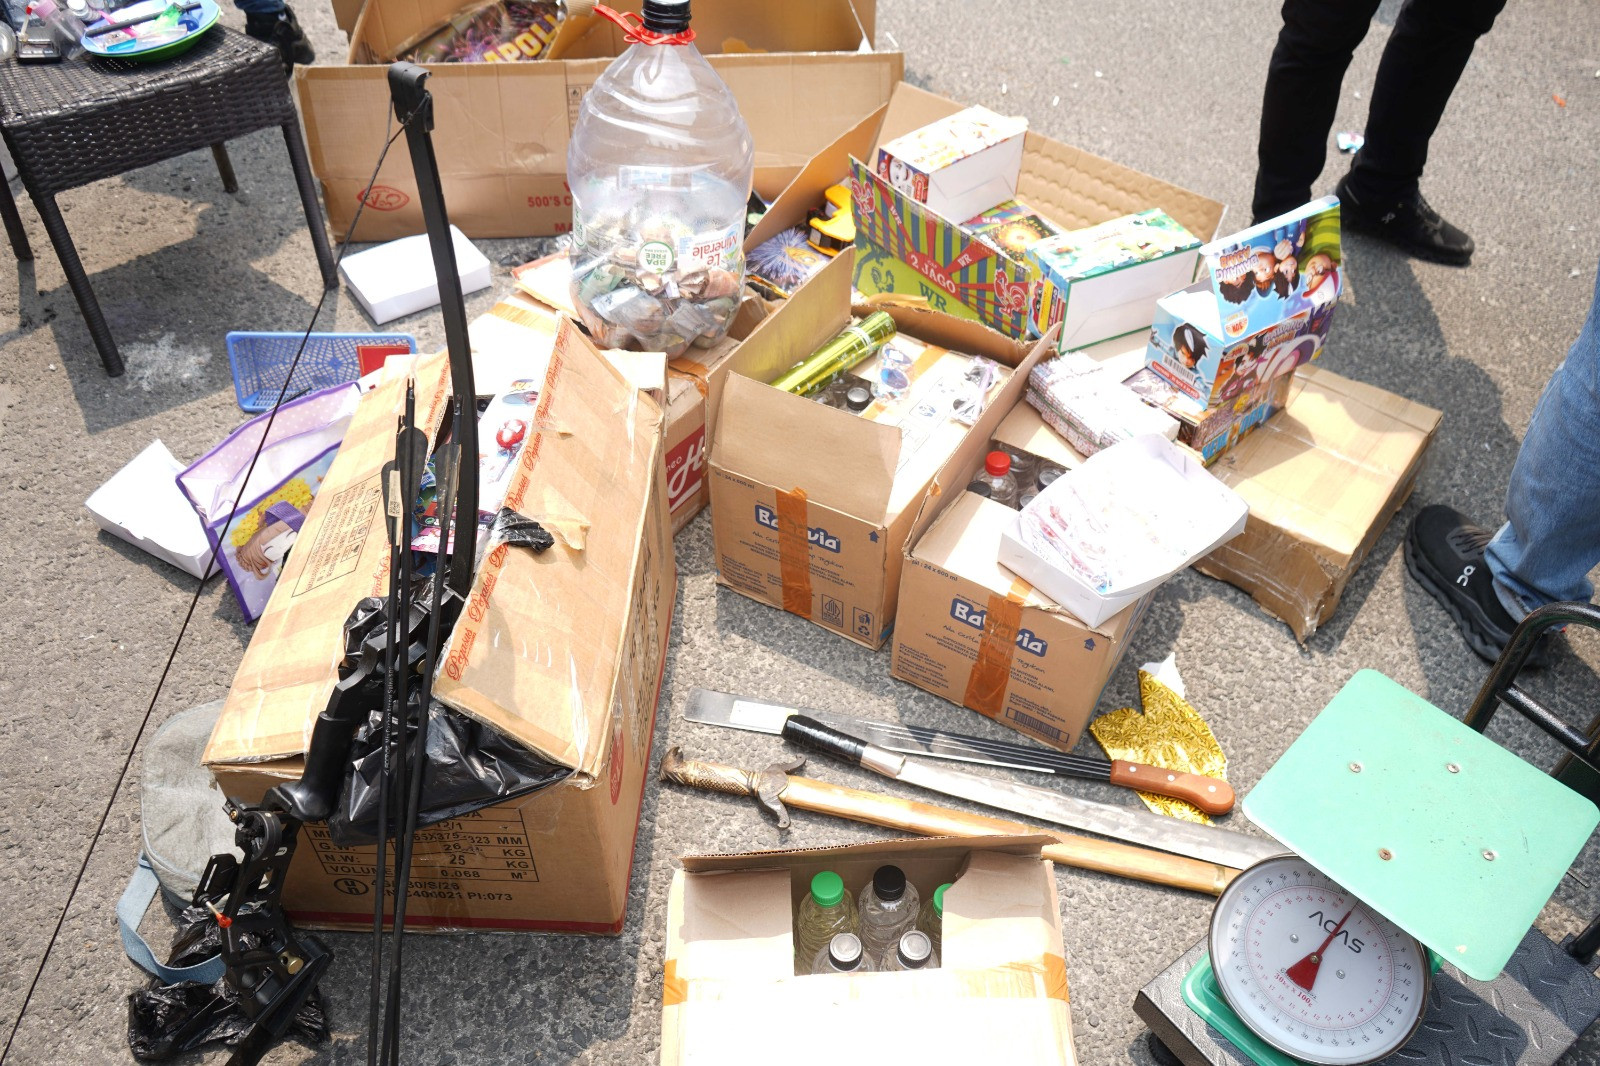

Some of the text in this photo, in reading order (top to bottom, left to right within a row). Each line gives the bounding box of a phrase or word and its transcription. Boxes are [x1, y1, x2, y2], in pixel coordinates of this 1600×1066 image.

[692, 232, 738, 266] Le Minerale
[958, 253, 973, 267] WR
[911, 254, 956, 294] 2 JAGO
[1215, 254, 1259, 282] BAWANG
[918, 280, 948, 312] WR
[758, 508, 838, 550] Bavia
[468, 572, 494, 624] Pegasus
[955, 602, 1044, 654] Bavia
[445, 628, 473, 681] Pegasus
[496, 836, 523, 845] MM
[444, 843, 461, 851] 26
[502, 849, 526, 857] KG
[324, 854, 530, 869] N.W: 25 KG
[440, 870, 480, 878] 0.068
[467, 892, 513, 901] PI:073
[1402, 962, 1412, 971] 10
[1402, 978, 1412, 987] 12
[1297, 992, 1313, 1008] 100g
[1400, 993, 1409, 1002] 14
[1394, 1007, 1403, 1015] 16
[1301, 1031, 1309, 1040] 30
[1331, 1038, 1339, 1046] 26
[1361, 1034, 1370, 1043] 22
